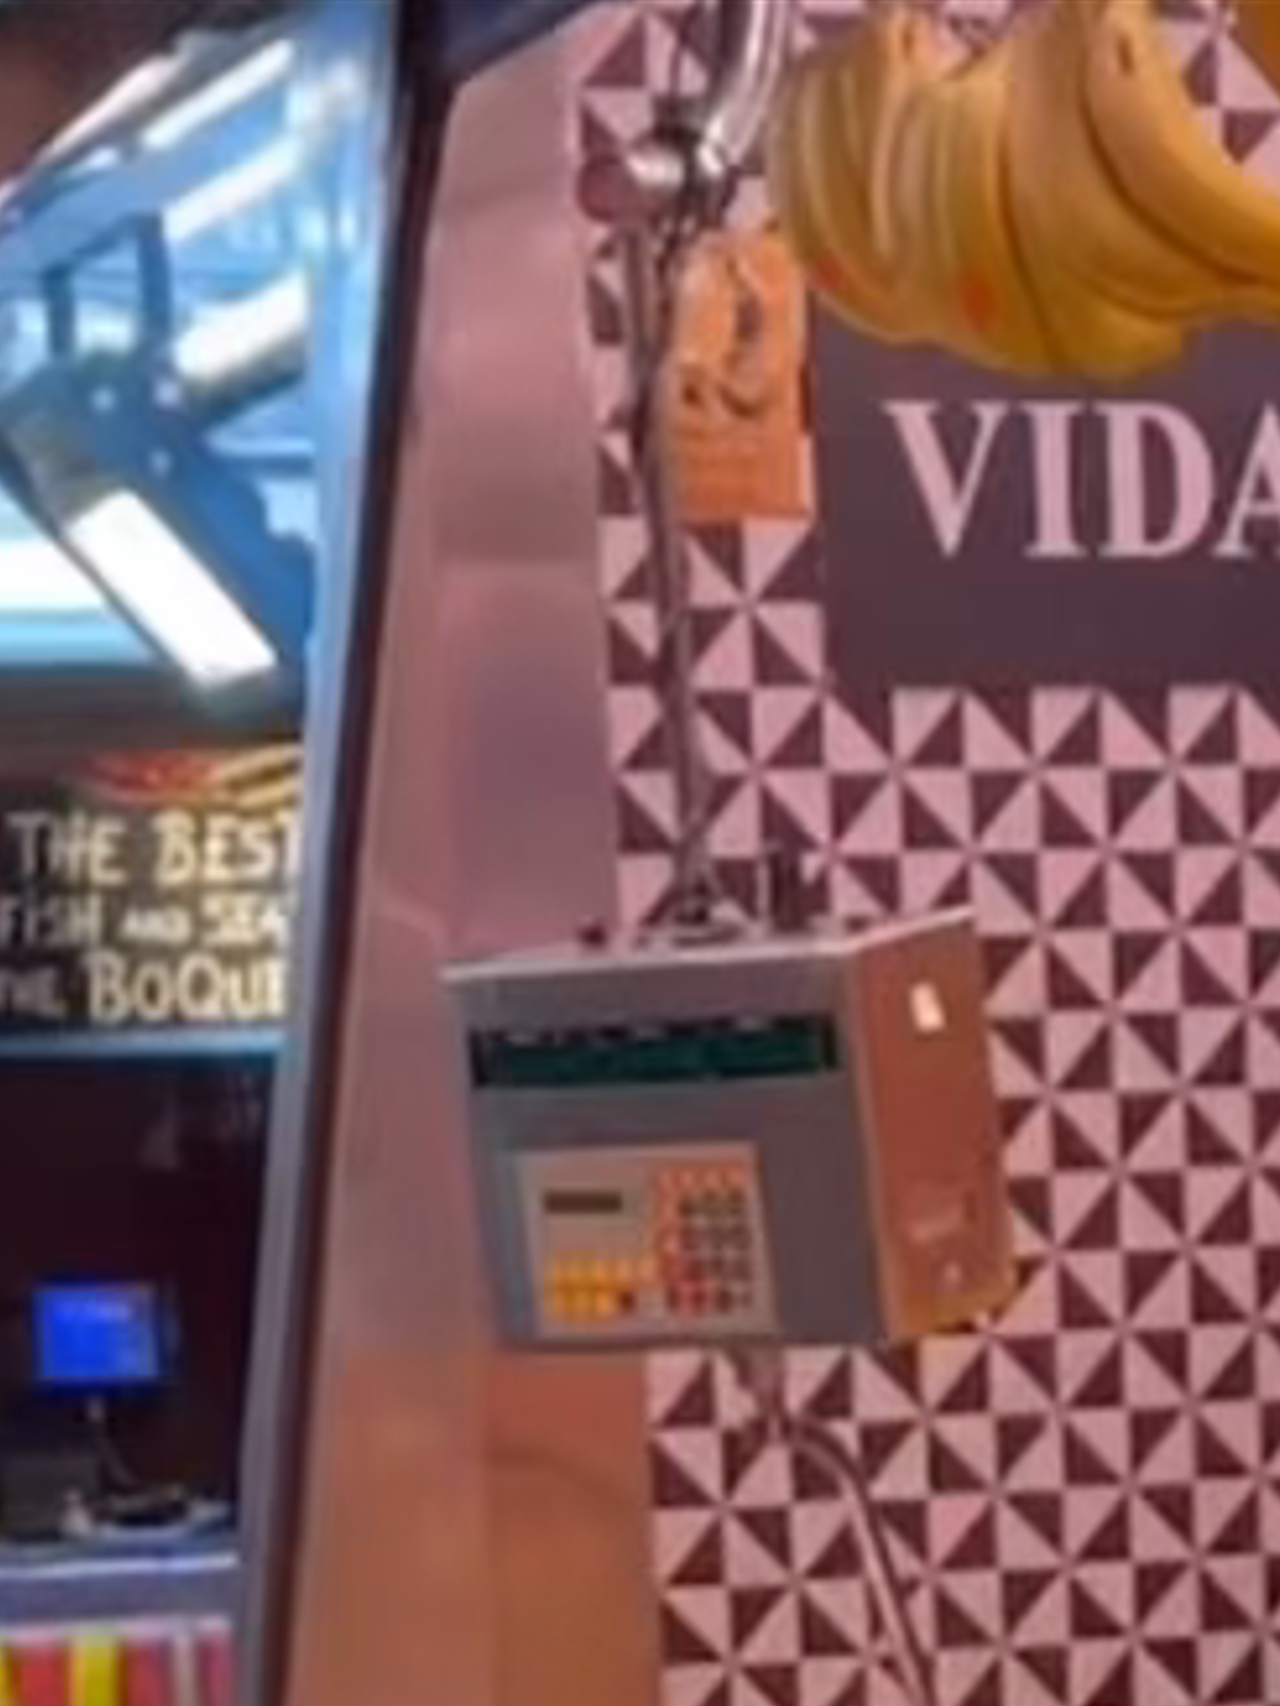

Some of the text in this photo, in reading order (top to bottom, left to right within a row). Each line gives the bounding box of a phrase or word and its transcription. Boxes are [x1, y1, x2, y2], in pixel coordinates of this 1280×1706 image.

[6, 808, 303, 888] THE BEST
[123, 903, 192, 944] AND
